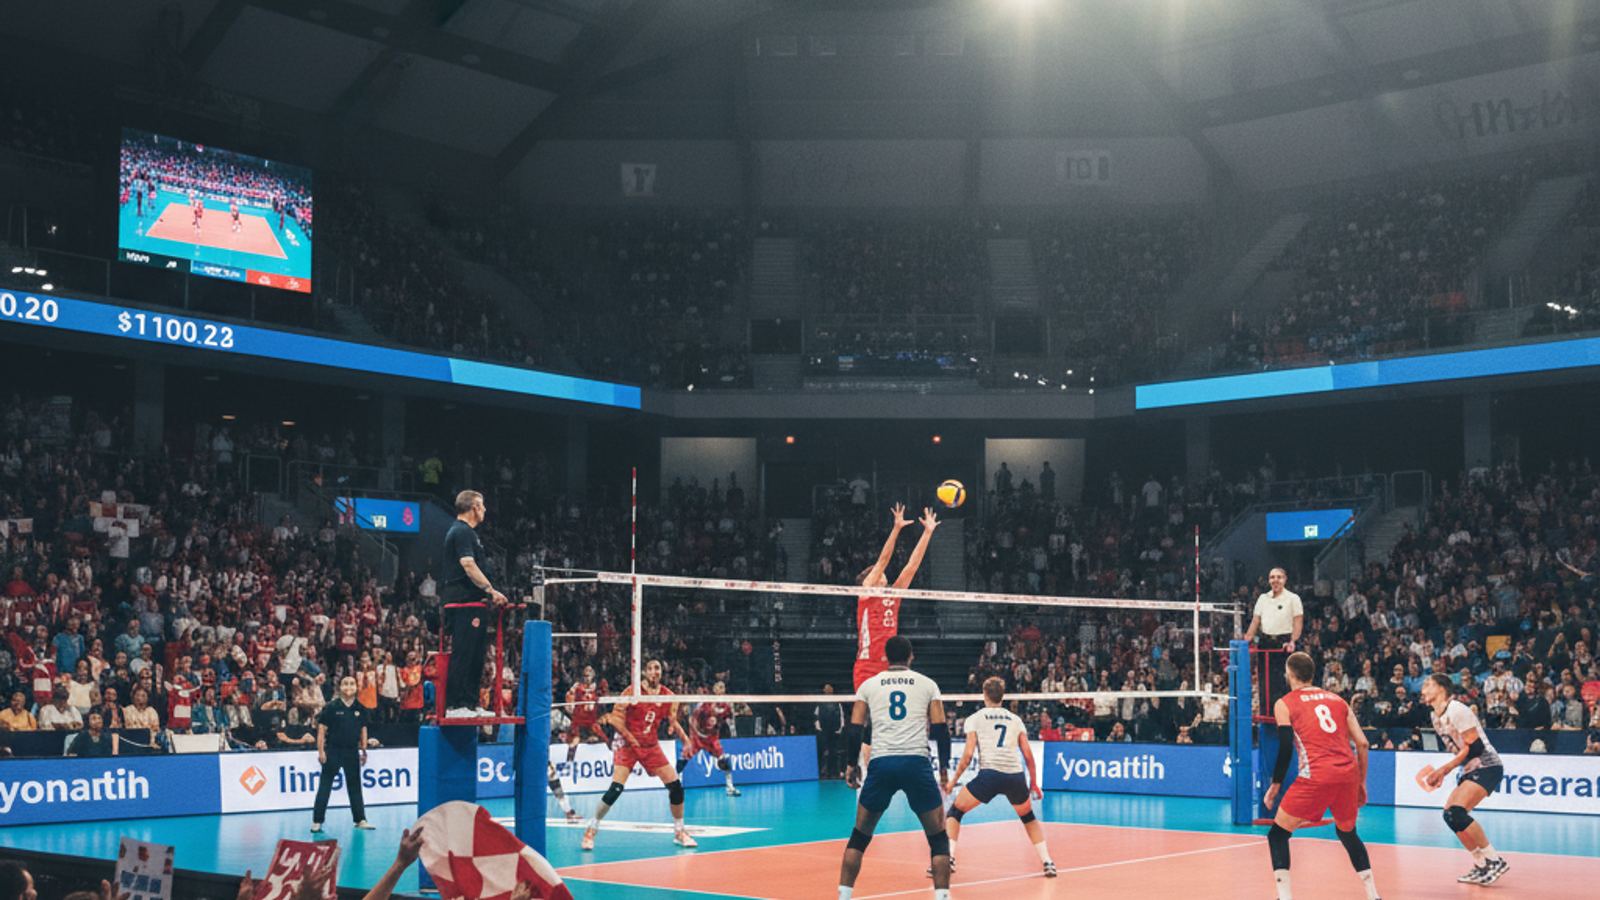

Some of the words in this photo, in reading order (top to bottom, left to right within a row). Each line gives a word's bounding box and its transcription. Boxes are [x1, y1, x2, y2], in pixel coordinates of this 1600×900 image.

[889, 690, 907, 721] 8
[1314, 704, 1337, 733] 8
[994, 724, 1007, 748] 7
